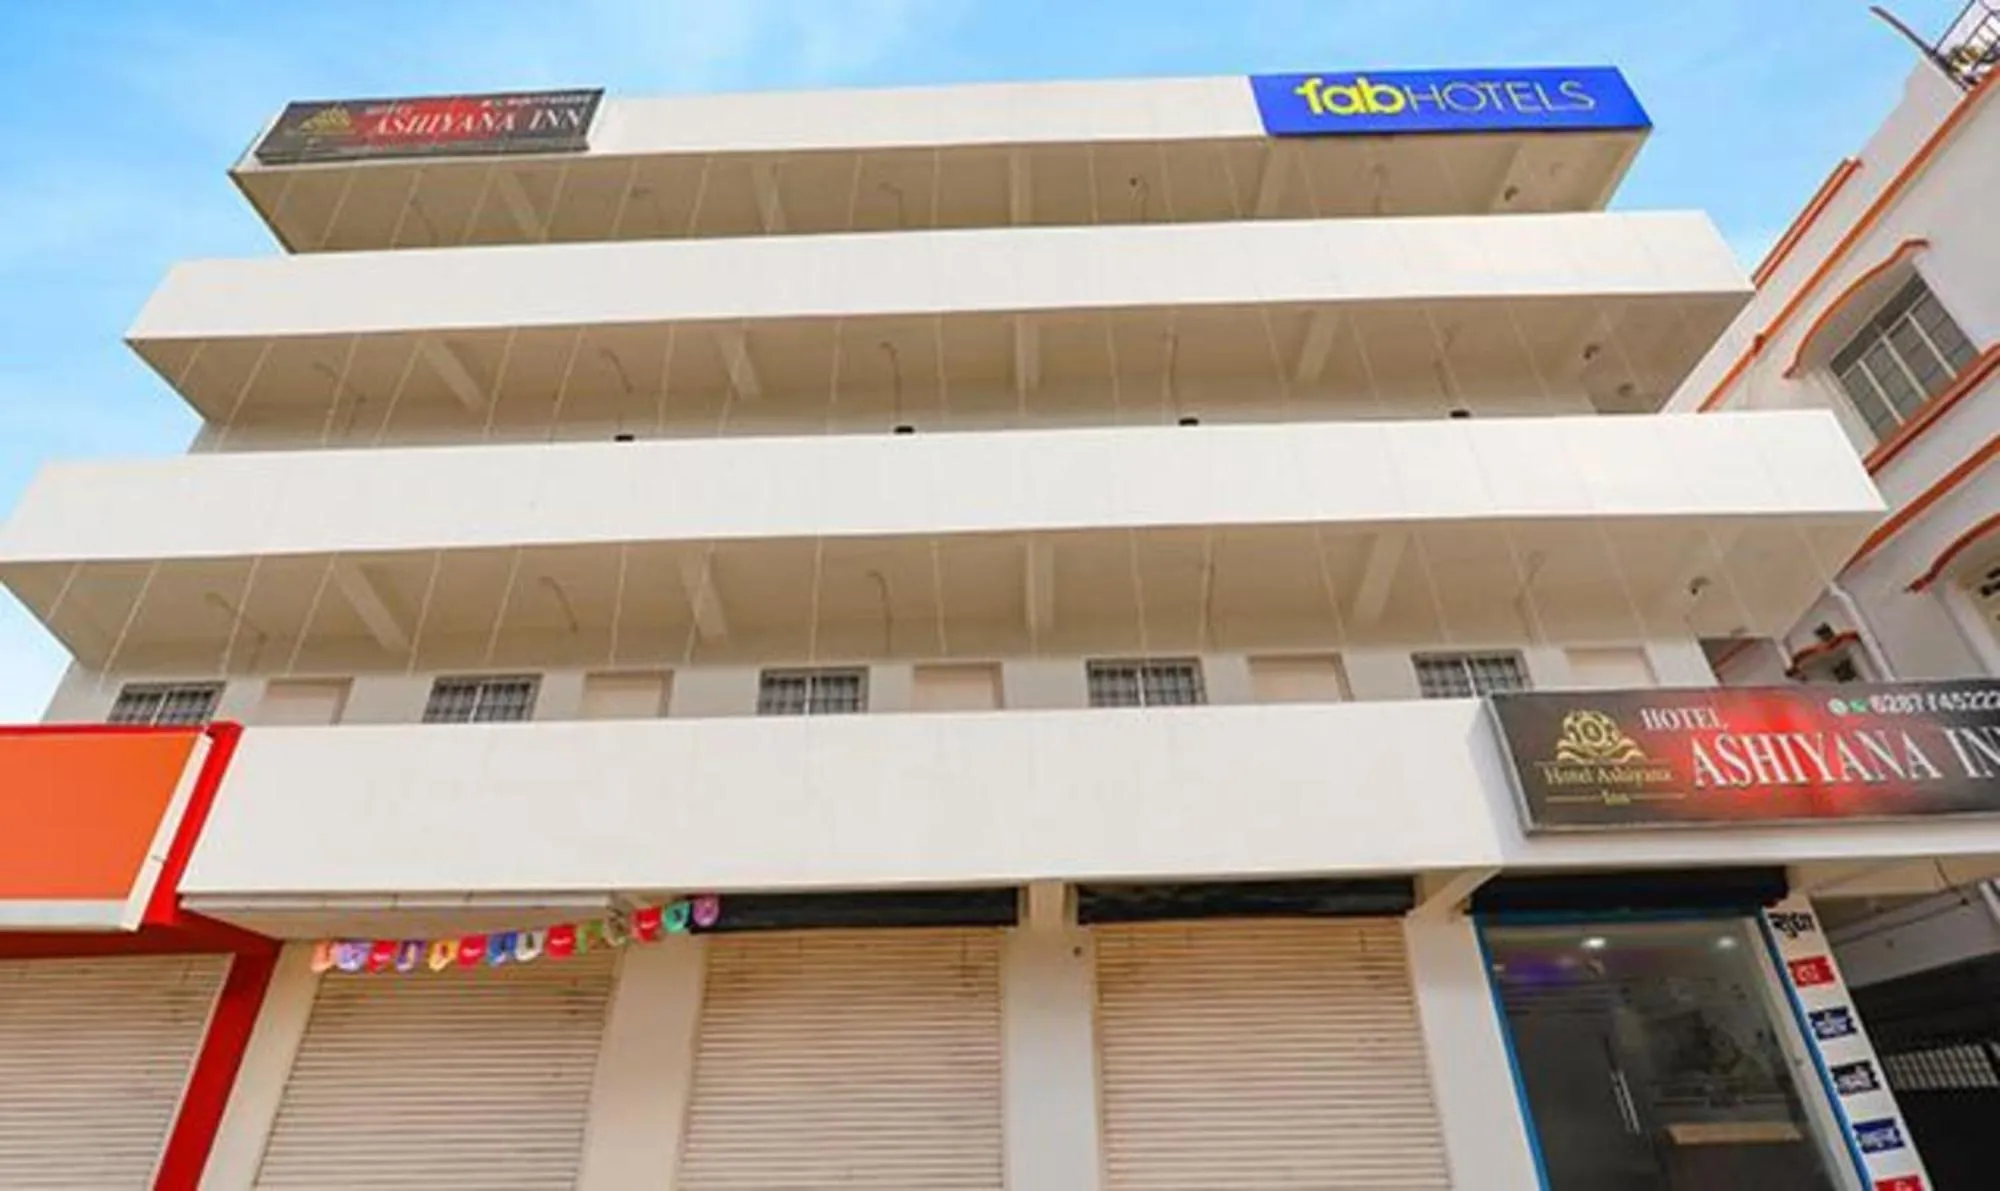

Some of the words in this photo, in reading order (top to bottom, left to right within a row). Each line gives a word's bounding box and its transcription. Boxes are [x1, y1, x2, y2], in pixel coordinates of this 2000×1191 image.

[1295, 76, 1597, 116] fabHOTELS
[376, 110, 516, 136] ASHIYANA
[528, 107, 587, 130] INN
[1638, 706, 1729, 731] HOTEL
[1690, 730, 1944, 789] ASHIYANA
[1941, 726, 2000, 779] IN
